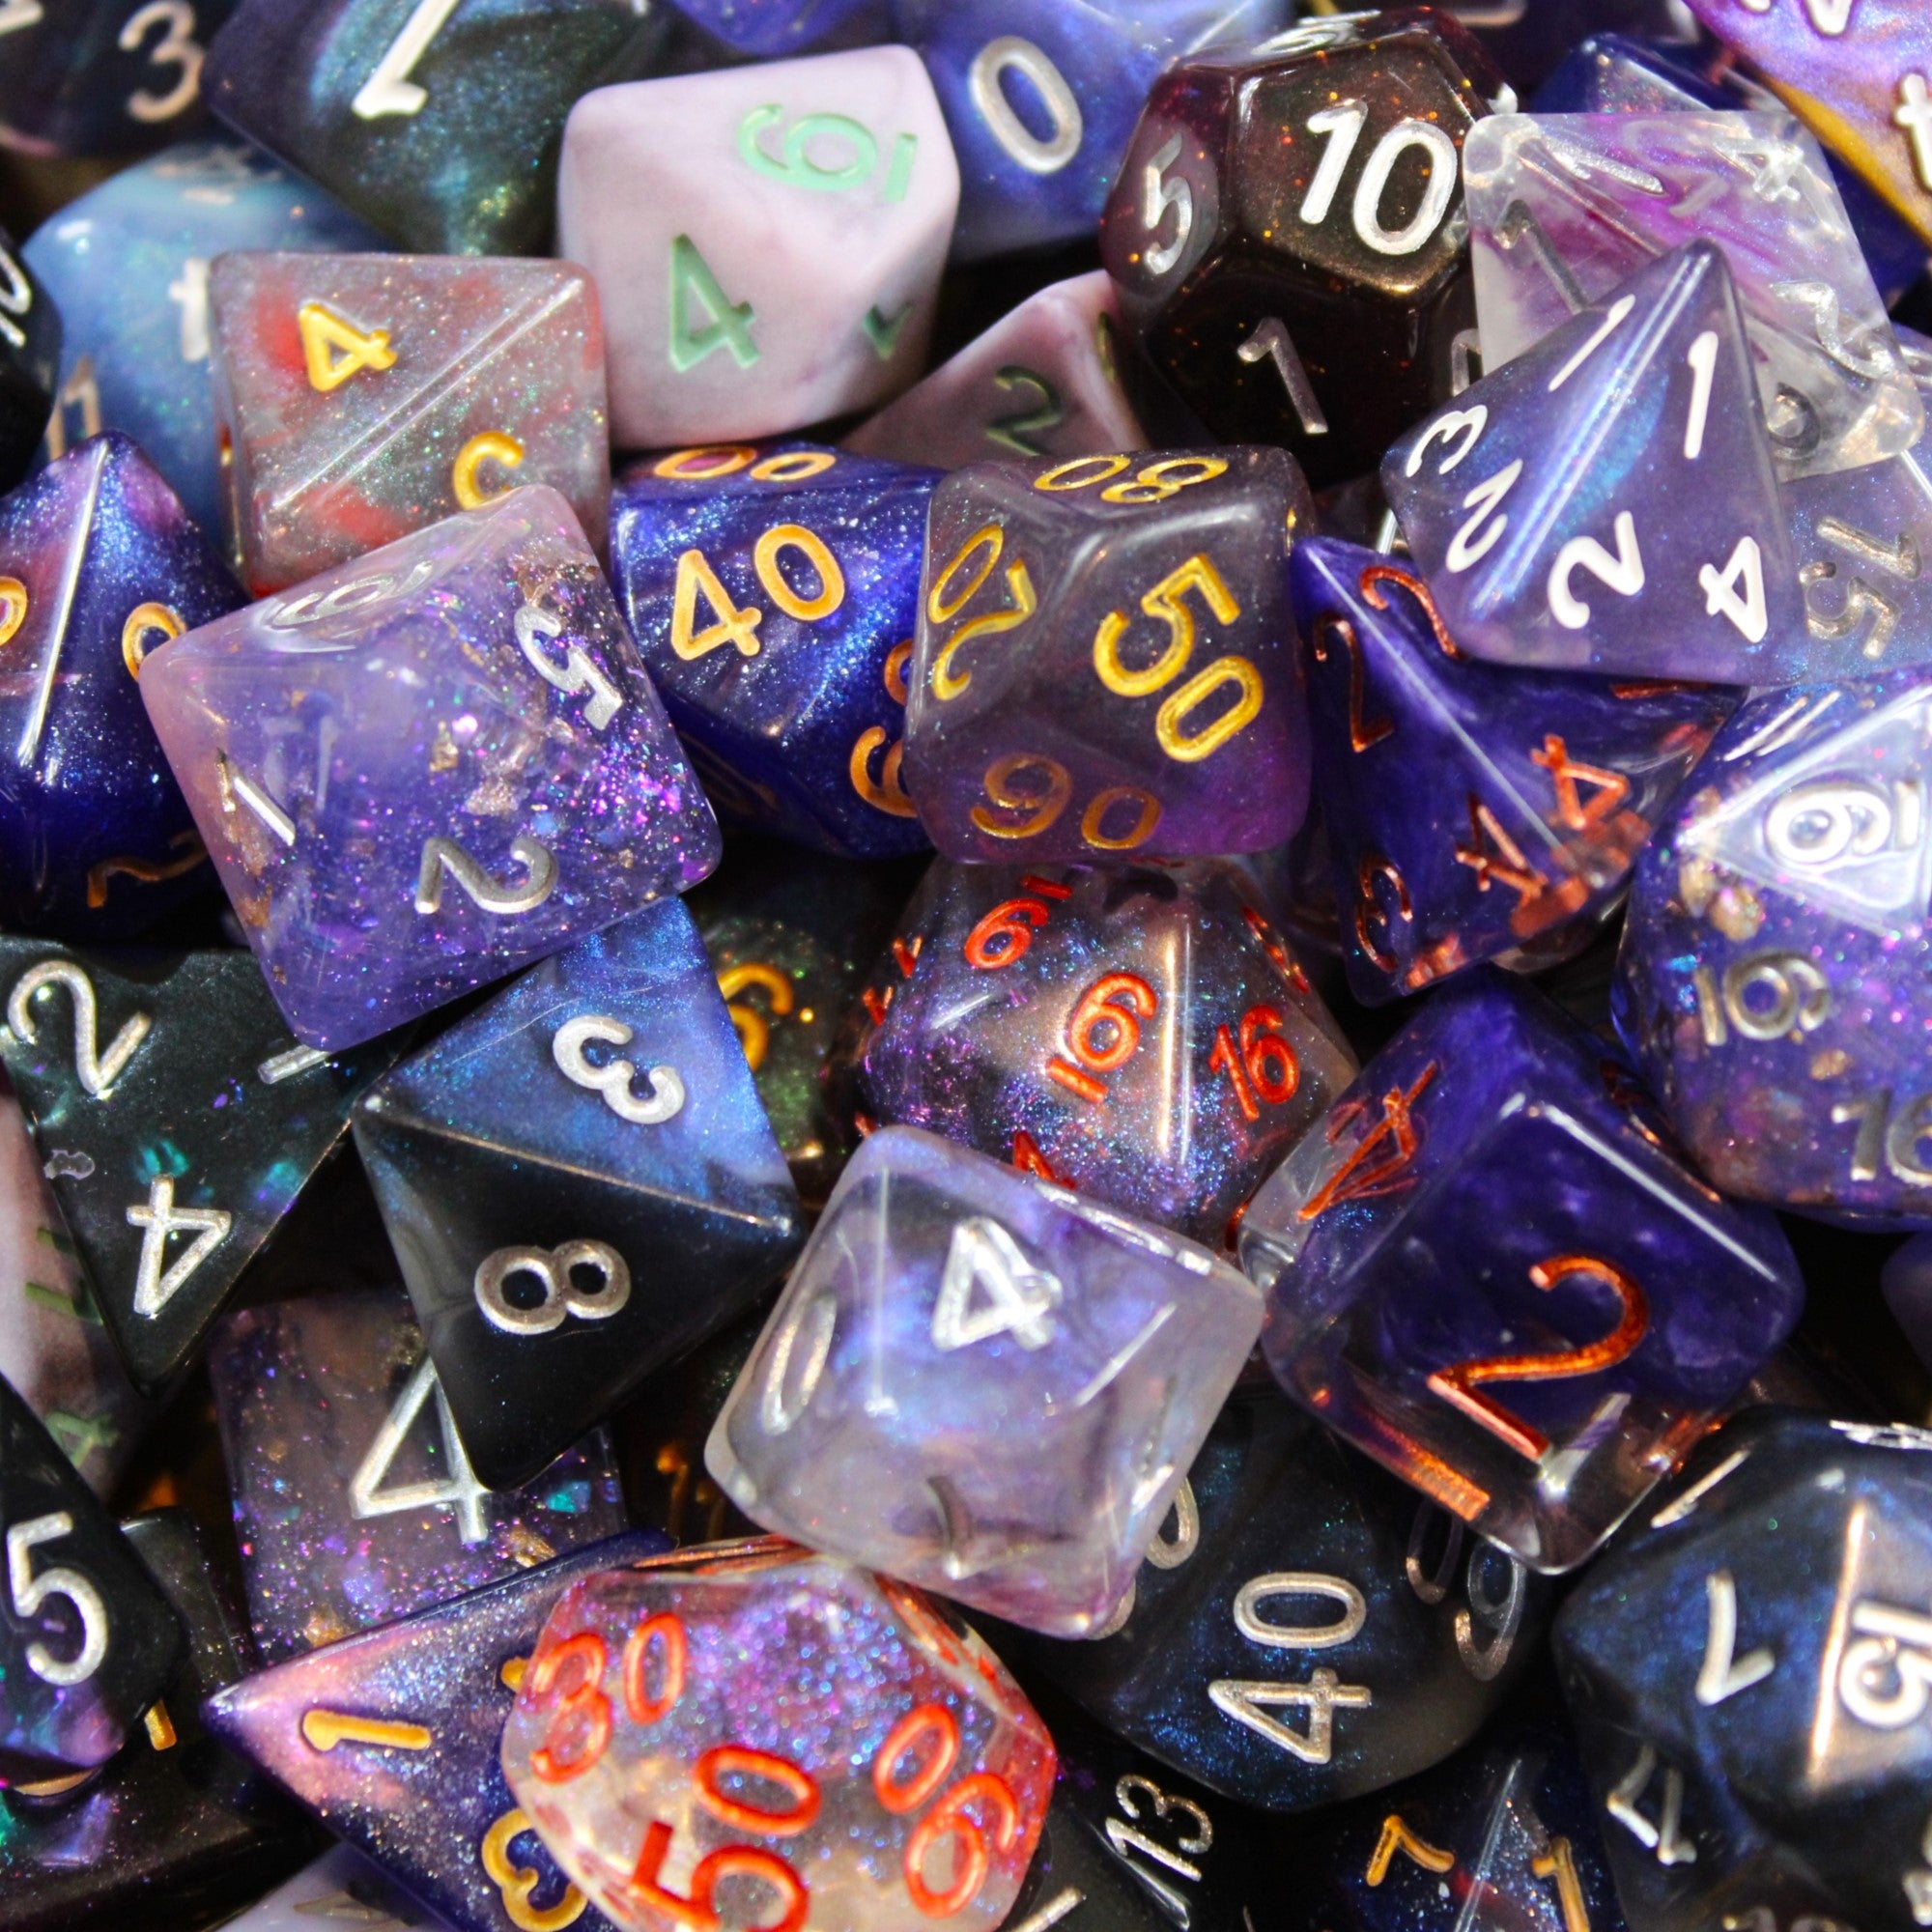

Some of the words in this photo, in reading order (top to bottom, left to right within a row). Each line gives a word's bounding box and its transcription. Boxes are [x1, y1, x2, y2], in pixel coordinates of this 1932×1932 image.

[118, 0, 205, 123] 3
[970, 36, 1082, 174] 0
[1144, 132, 1194, 274] 5
[1300, 99, 1458, 255] 10
[298, 298, 398, 392] 4
[669, 233, 760, 374] 4
[985, 365, 1064, 457] 2
[1237, 317, 1328, 435] 1
[1688, 331, 1719, 459] 1
[1406, 405, 1489, 478] 3
[1446, 459, 1522, 573] 2
[1548, 511, 1645, 629] 2
[670, 524, 845, 661] 40
[1699, 535, 1768, 643] 4
[514, 606, 623, 731] 5
[1094, 554, 1264, 762] 50
[971, 753, 1161, 849] 90
[415, 838, 558, 913] 2
[8, 959, 151, 1097] 2
[554, 1015, 685, 1124] 3
[1208, 1005, 1300, 1121] 16
[126, 1173, 232, 1316] 4
[473, 1239, 631, 1335] 8
[932, 1215, 1063, 1350] 4
[1427, 1256, 1650, 1463] 2
[351, 1352, 494, 1546] 4
[7, 1510, 108, 1686] 5
[1694, 1568, 1776, 1706] 7
[302, 1709, 432, 1751] 1
[531, 1610, 688, 1785] 30
[1208, 1569, 1373, 1765] 40
[630, 1746, 821, 1932] 50
[1103, 1774, 1213, 1883] 13
